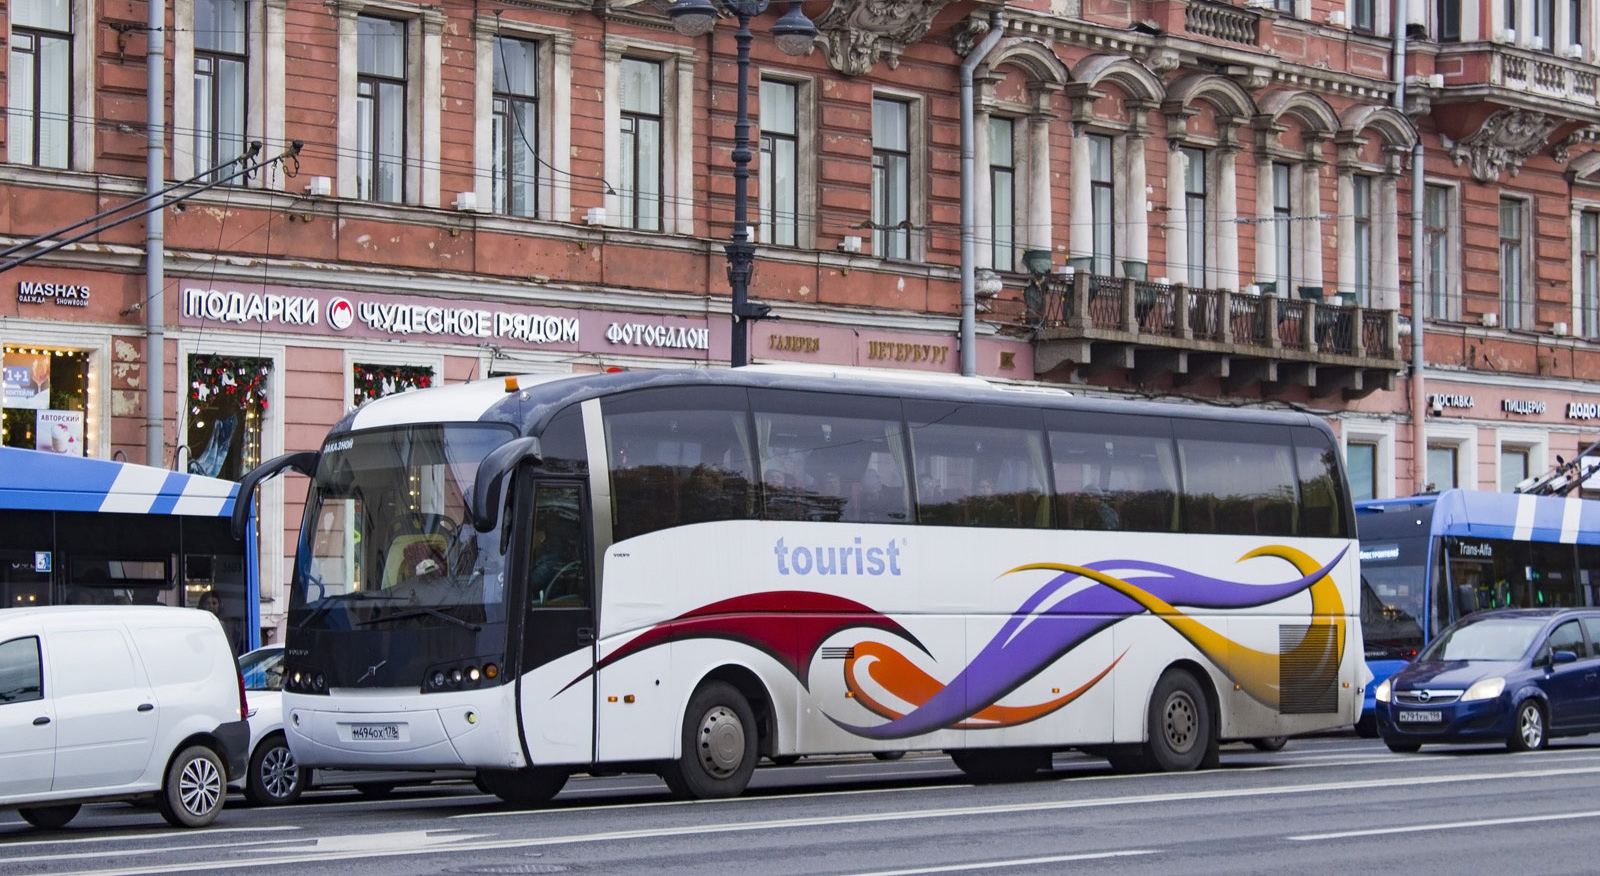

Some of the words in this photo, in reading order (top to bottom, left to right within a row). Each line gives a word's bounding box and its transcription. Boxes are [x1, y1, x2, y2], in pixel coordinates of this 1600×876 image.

[19, 282, 91, 299] MASHA'S
[19, 295, 46, 304] ОДЕЖДА
[56, 298, 89, 307] SHOWROOM
[183, 288, 319, 326] ПОДАРКИ
[358, 301, 492, 337] ЧУДЕСНОЕ
[494, 311, 580, 344] РЯДОМ
[606, 322, 709, 350] ФОТОСАЛОН
[769, 334, 820, 353] ГАЛЕРЕЯ
[868, 340, 949, 364] ПЕТЕРБУРГ
[1503, 399, 1546, 415] ПИЦЦЕРИЯ
[1567, 402, 1597, 420] ДОДО
[40, 414, 80, 422] АВТОРСКИЙ
[774, 536, 901, 576] tourist
[1460, 542, 1492, 556] Trans-Alfa
